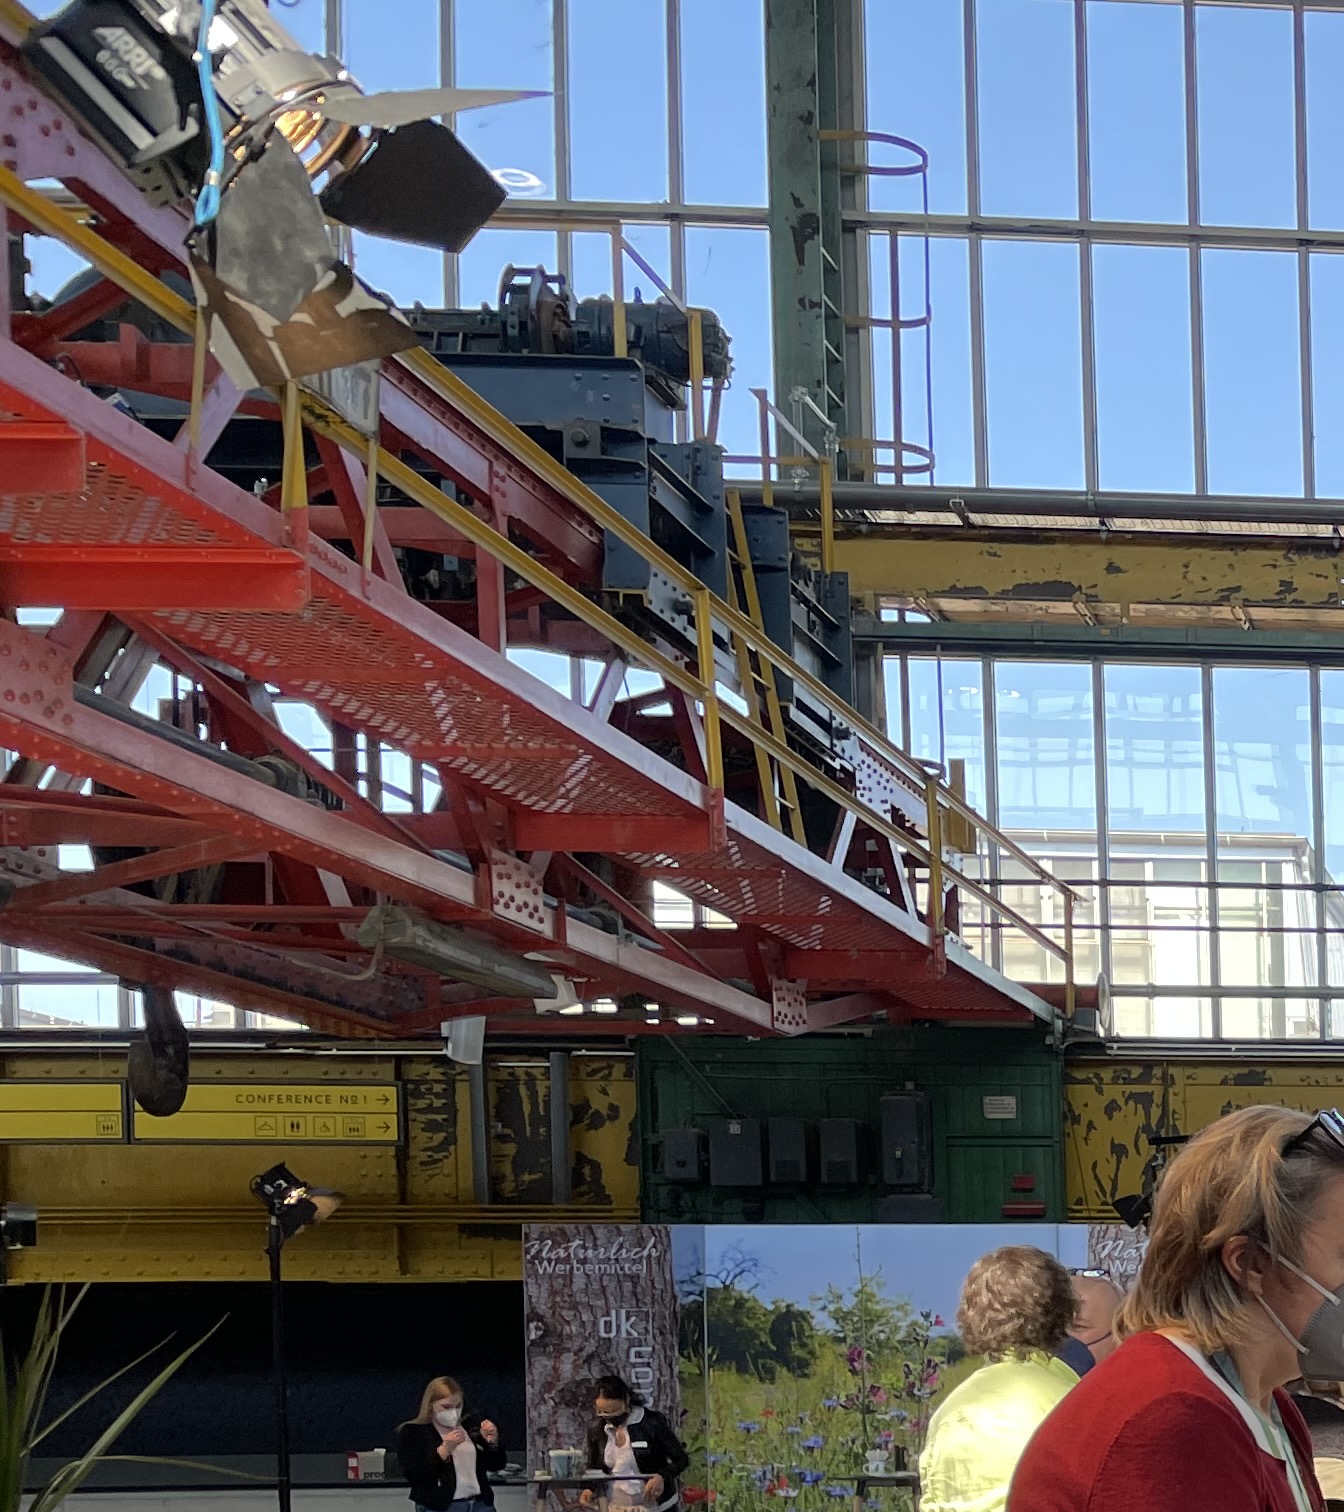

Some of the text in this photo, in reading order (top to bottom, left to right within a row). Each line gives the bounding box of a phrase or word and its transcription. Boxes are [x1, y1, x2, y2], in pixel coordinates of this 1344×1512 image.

[235, 1094, 332, 1105] CONFERENCE
[535, 1258, 647, 1275] Werbemittel
[599, 1308, 639, 1338] dk
